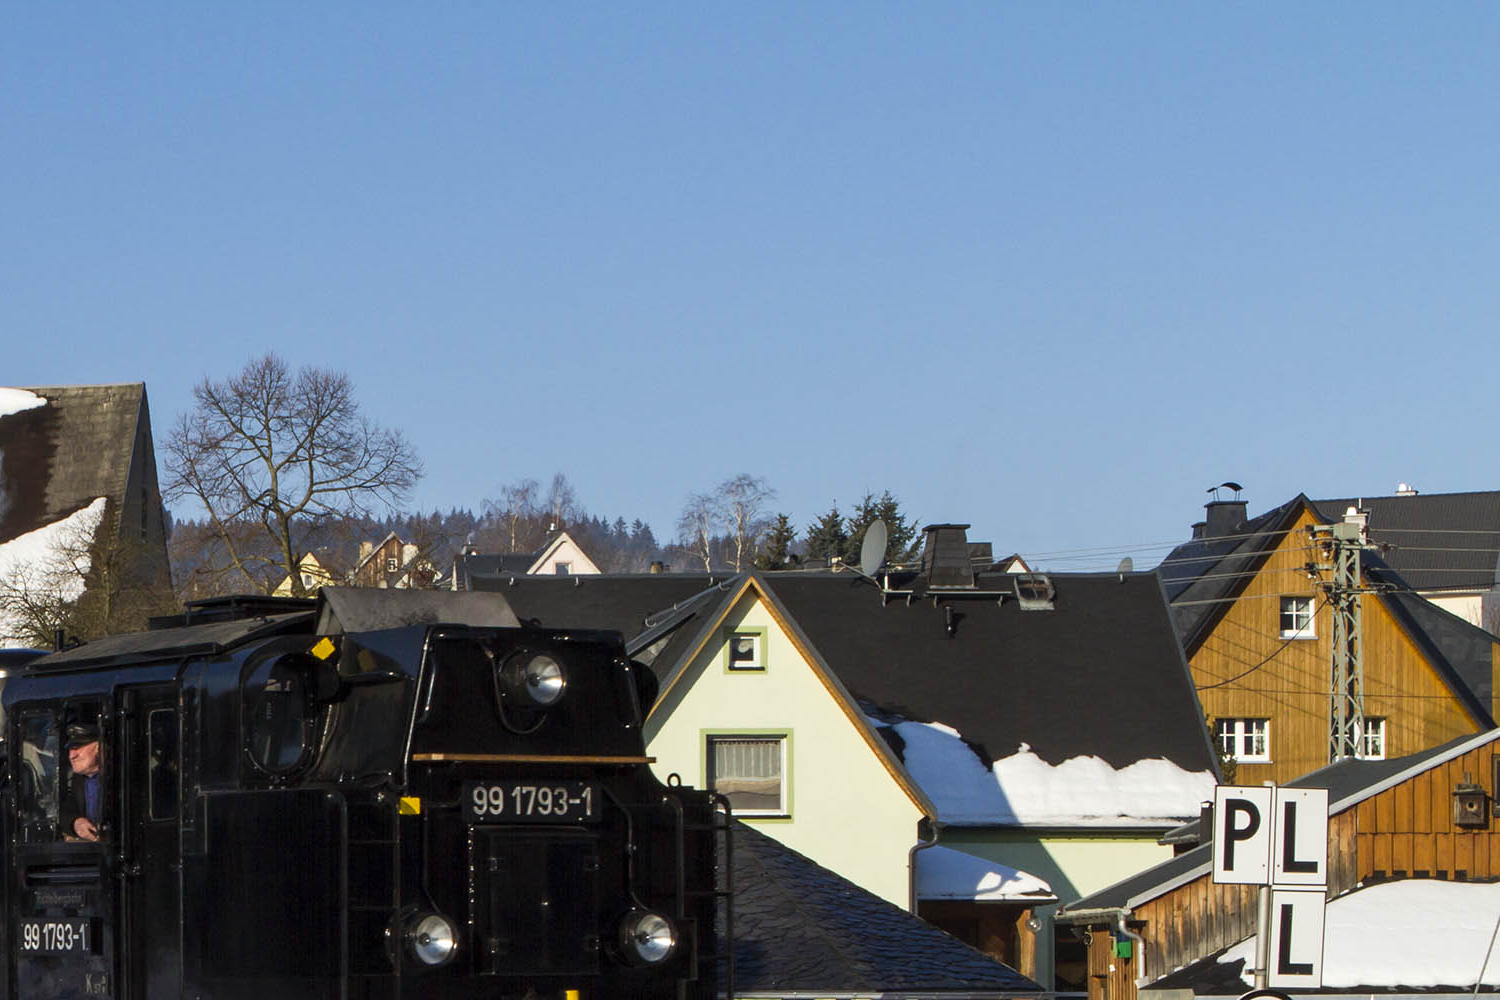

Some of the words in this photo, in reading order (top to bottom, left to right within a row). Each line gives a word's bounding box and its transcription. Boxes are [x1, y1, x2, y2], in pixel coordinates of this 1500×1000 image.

[472, 786, 504, 815] 99
[511, 786, 592, 816] 1793-1
[1223, 798, 1261, 872] P
[1282, 801, 1318, 874] L
[23, 923, 40, 950] 99
[43, 923, 86, 951] 1793-1
[1277, 903, 1314, 976] L
